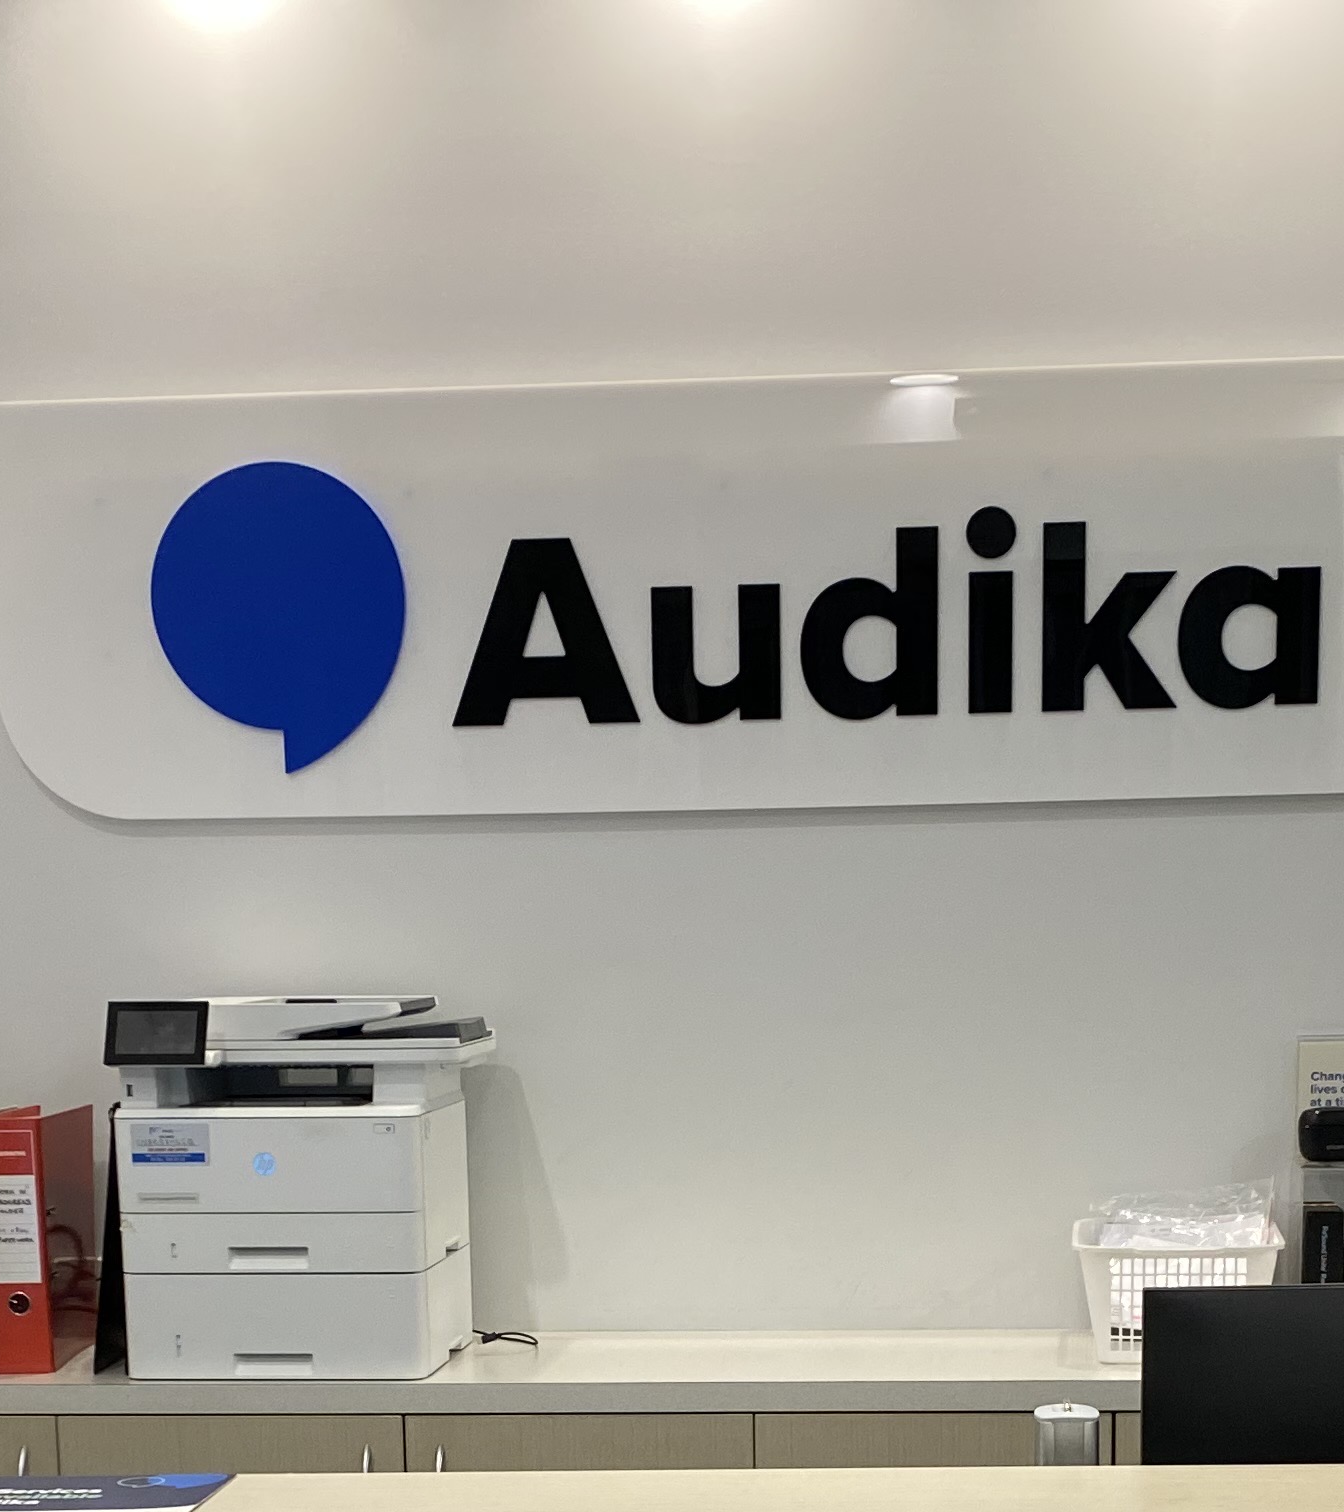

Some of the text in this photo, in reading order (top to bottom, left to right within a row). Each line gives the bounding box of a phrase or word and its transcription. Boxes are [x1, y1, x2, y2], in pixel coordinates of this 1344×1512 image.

[452, 505, 1322, 727] Audika
[1310, 1084, 1338, 1094] lives
[1309, 1097, 1322, 1107] at
[1324, 1099, 1332, 1107] a
